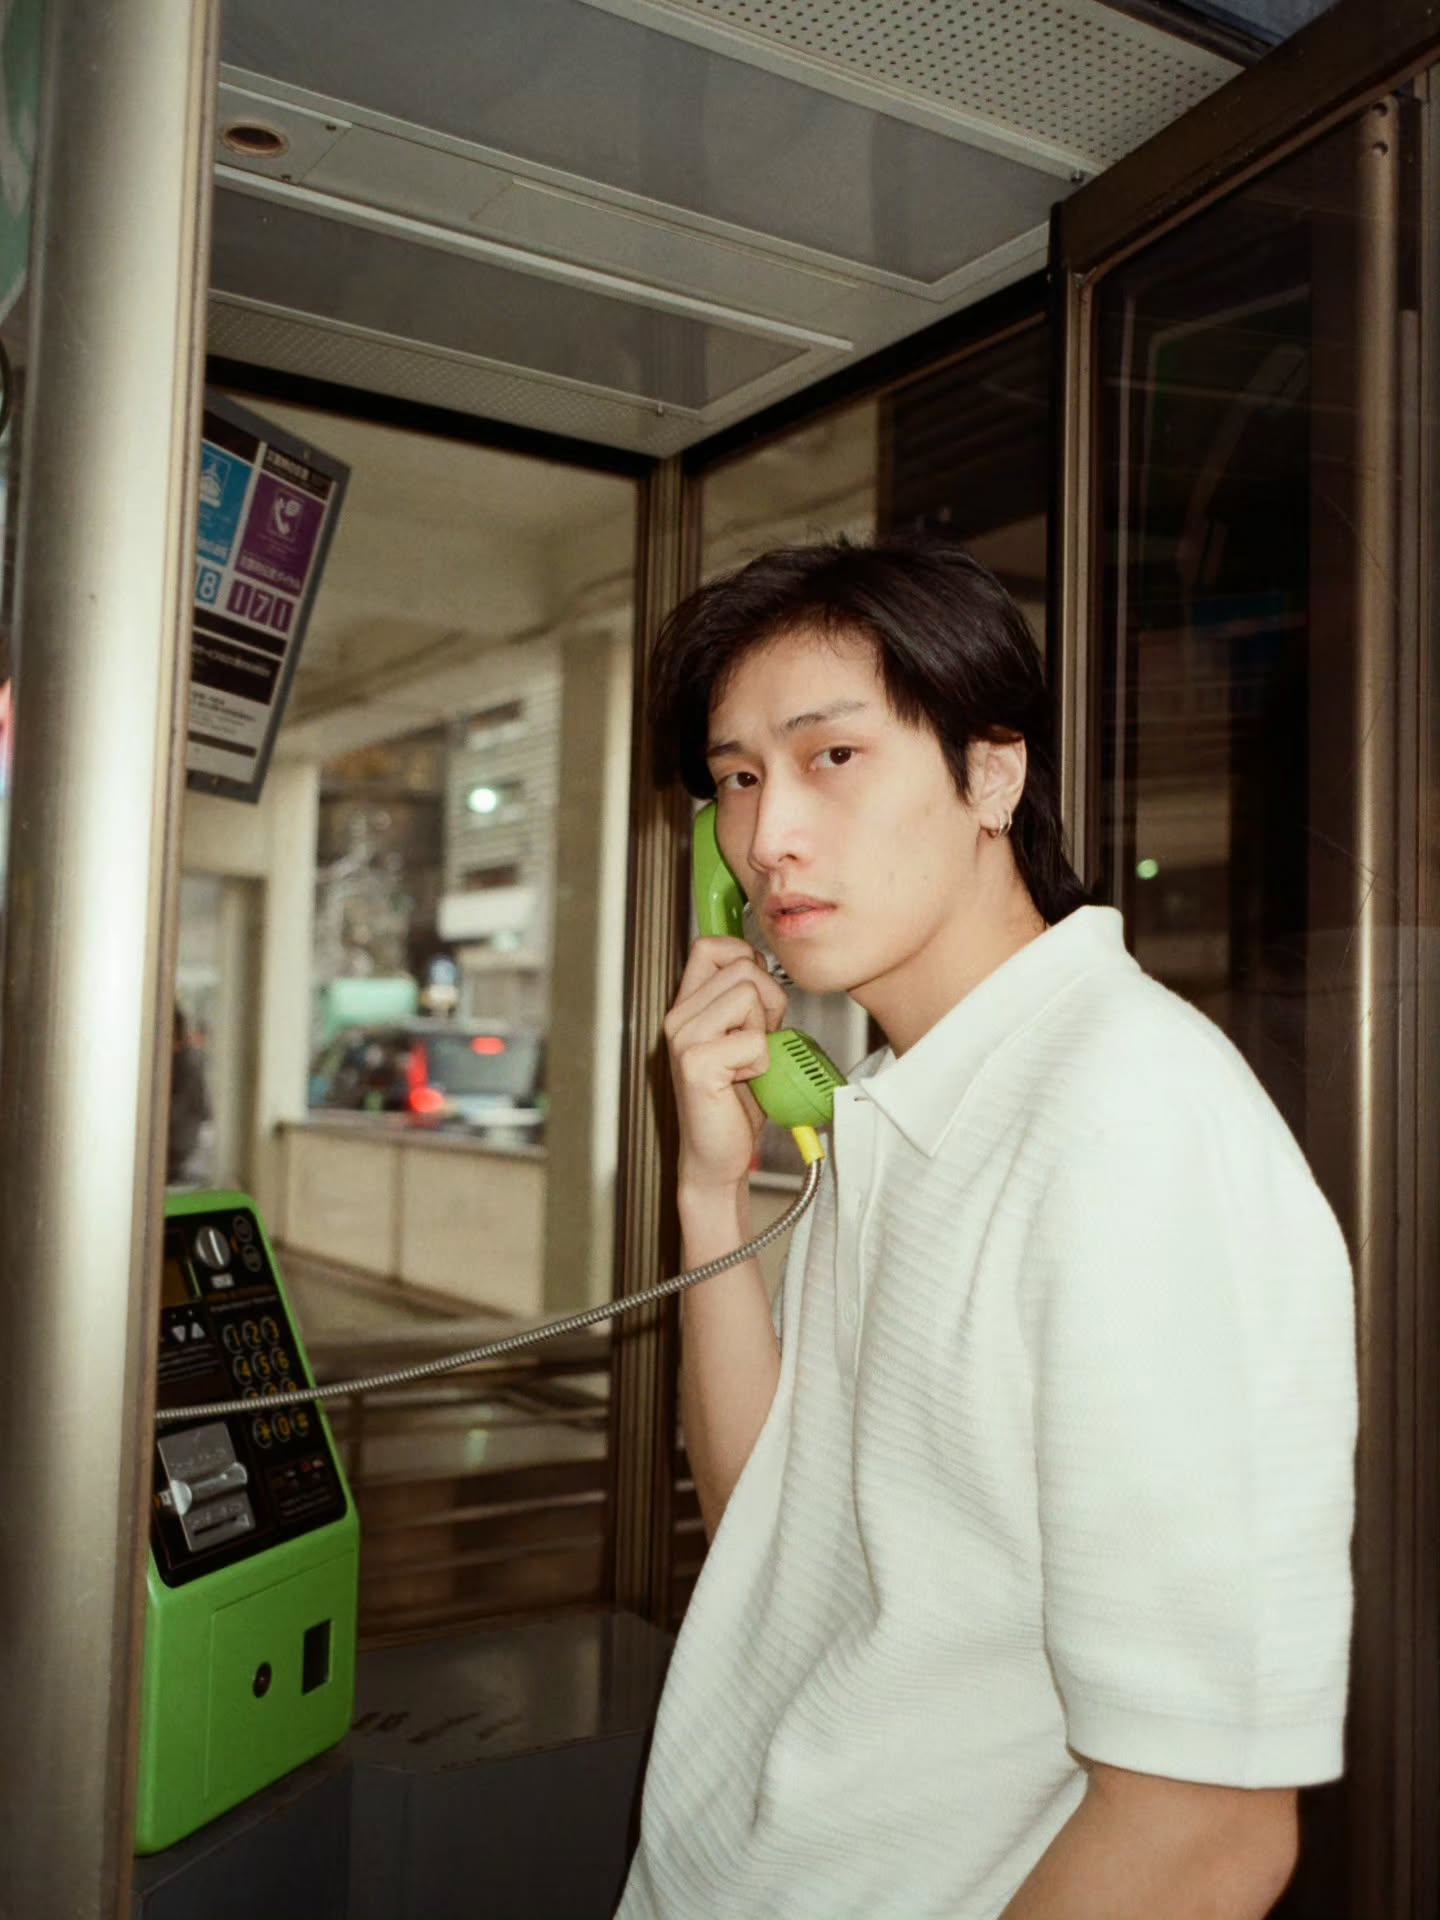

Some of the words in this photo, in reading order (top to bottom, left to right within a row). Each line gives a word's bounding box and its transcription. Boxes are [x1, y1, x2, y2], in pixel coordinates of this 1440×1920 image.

[235, 585, 287, 630] 171
[260, 1354, 271, 1377] 5
[279, 1415, 291, 1436] 0
